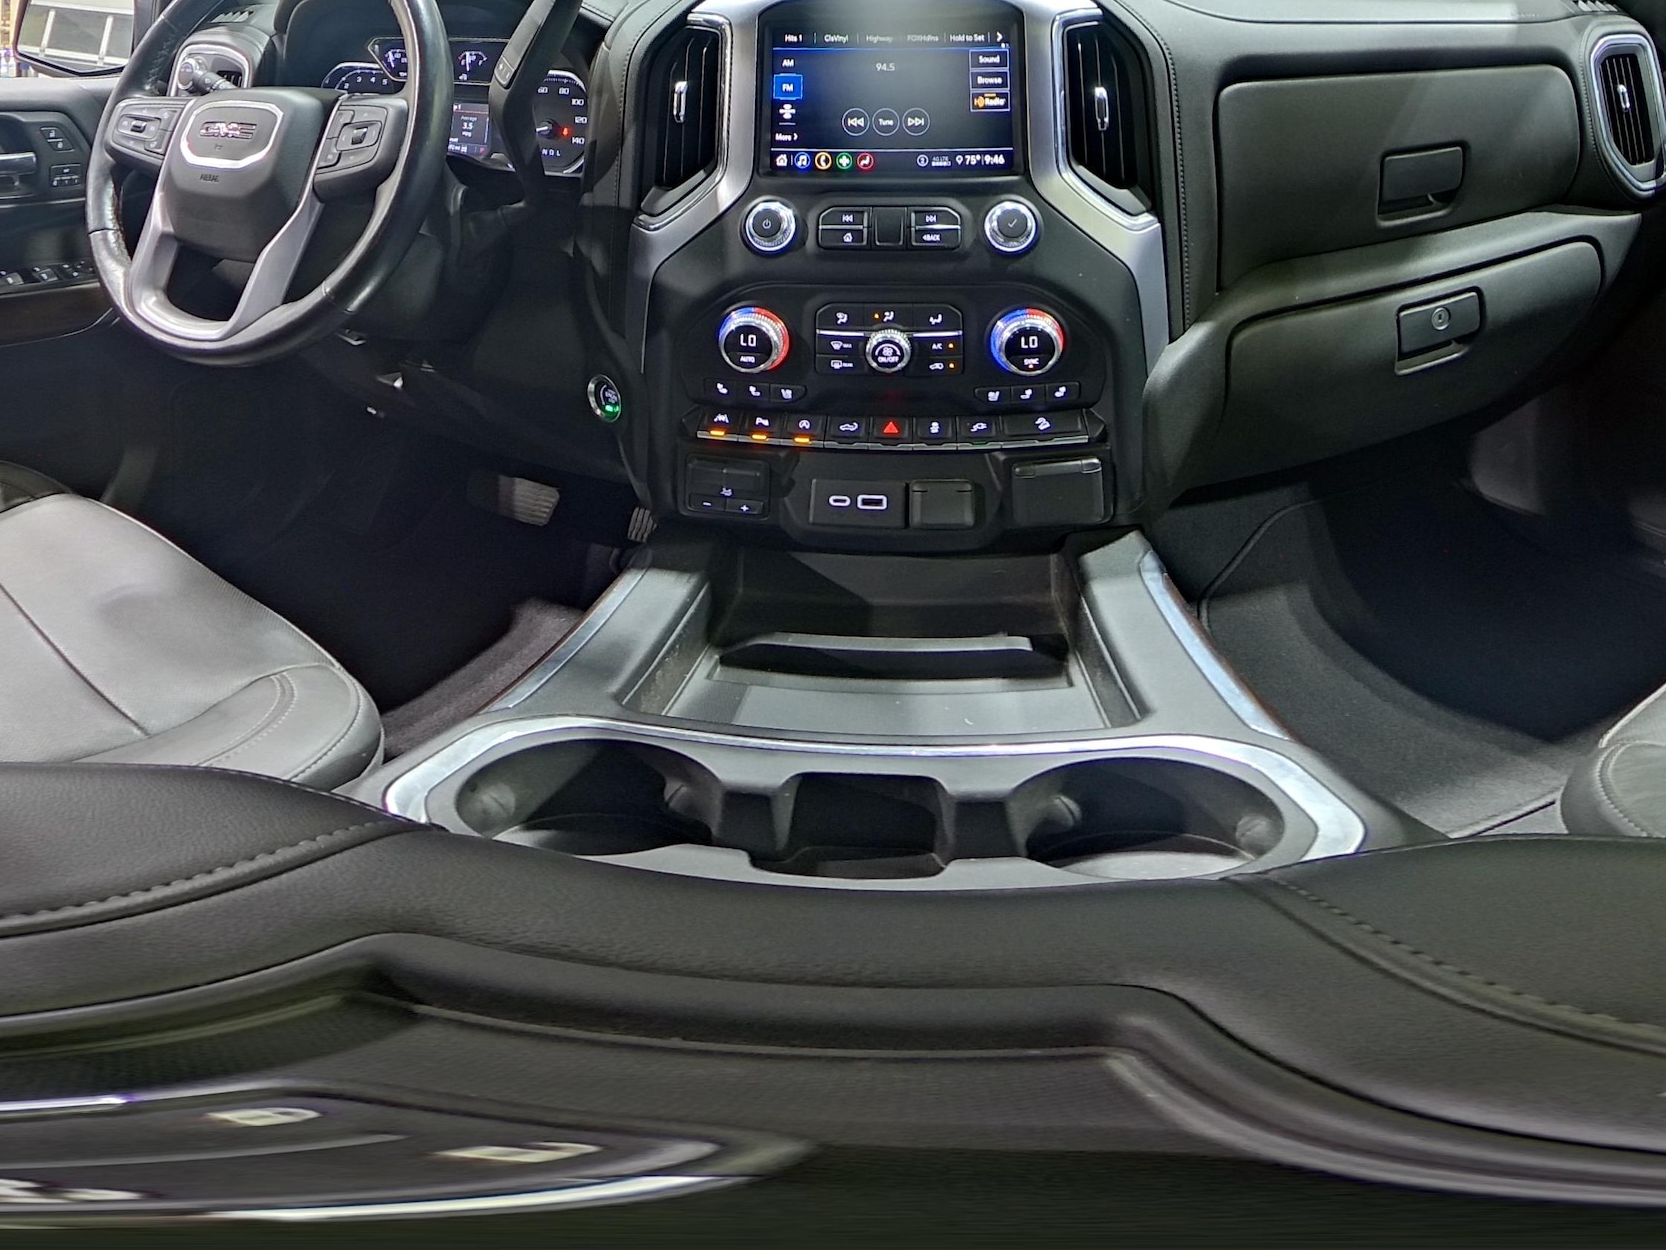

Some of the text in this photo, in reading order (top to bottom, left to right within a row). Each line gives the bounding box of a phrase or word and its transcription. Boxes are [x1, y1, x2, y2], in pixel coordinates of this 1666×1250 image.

[785, 34, 798, 42] Hits
[950, 34, 984, 42] Hold to Set
[782, 59, 794, 67] AM
[978, 55, 1000, 63] Sound
[876, 63, 895, 71] 94.5
[977, 76, 1002, 84] Browse
[559, 87, 570, 95] 80
[782, 84, 794, 92] FM
[571, 98, 584, 106] 100
[462, 122, 473, 130] 3.5
[878, 118, 893, 126] Tune
[199, 121, 257, 140] GMC
[571, 137, 585, 145] 140
[984, 154, 1005, 165] 9:46
[740, 333, 757, 347] LO
[1021, 335, 1038, 348] LO
[740, 355, 755, 363] AUTO
